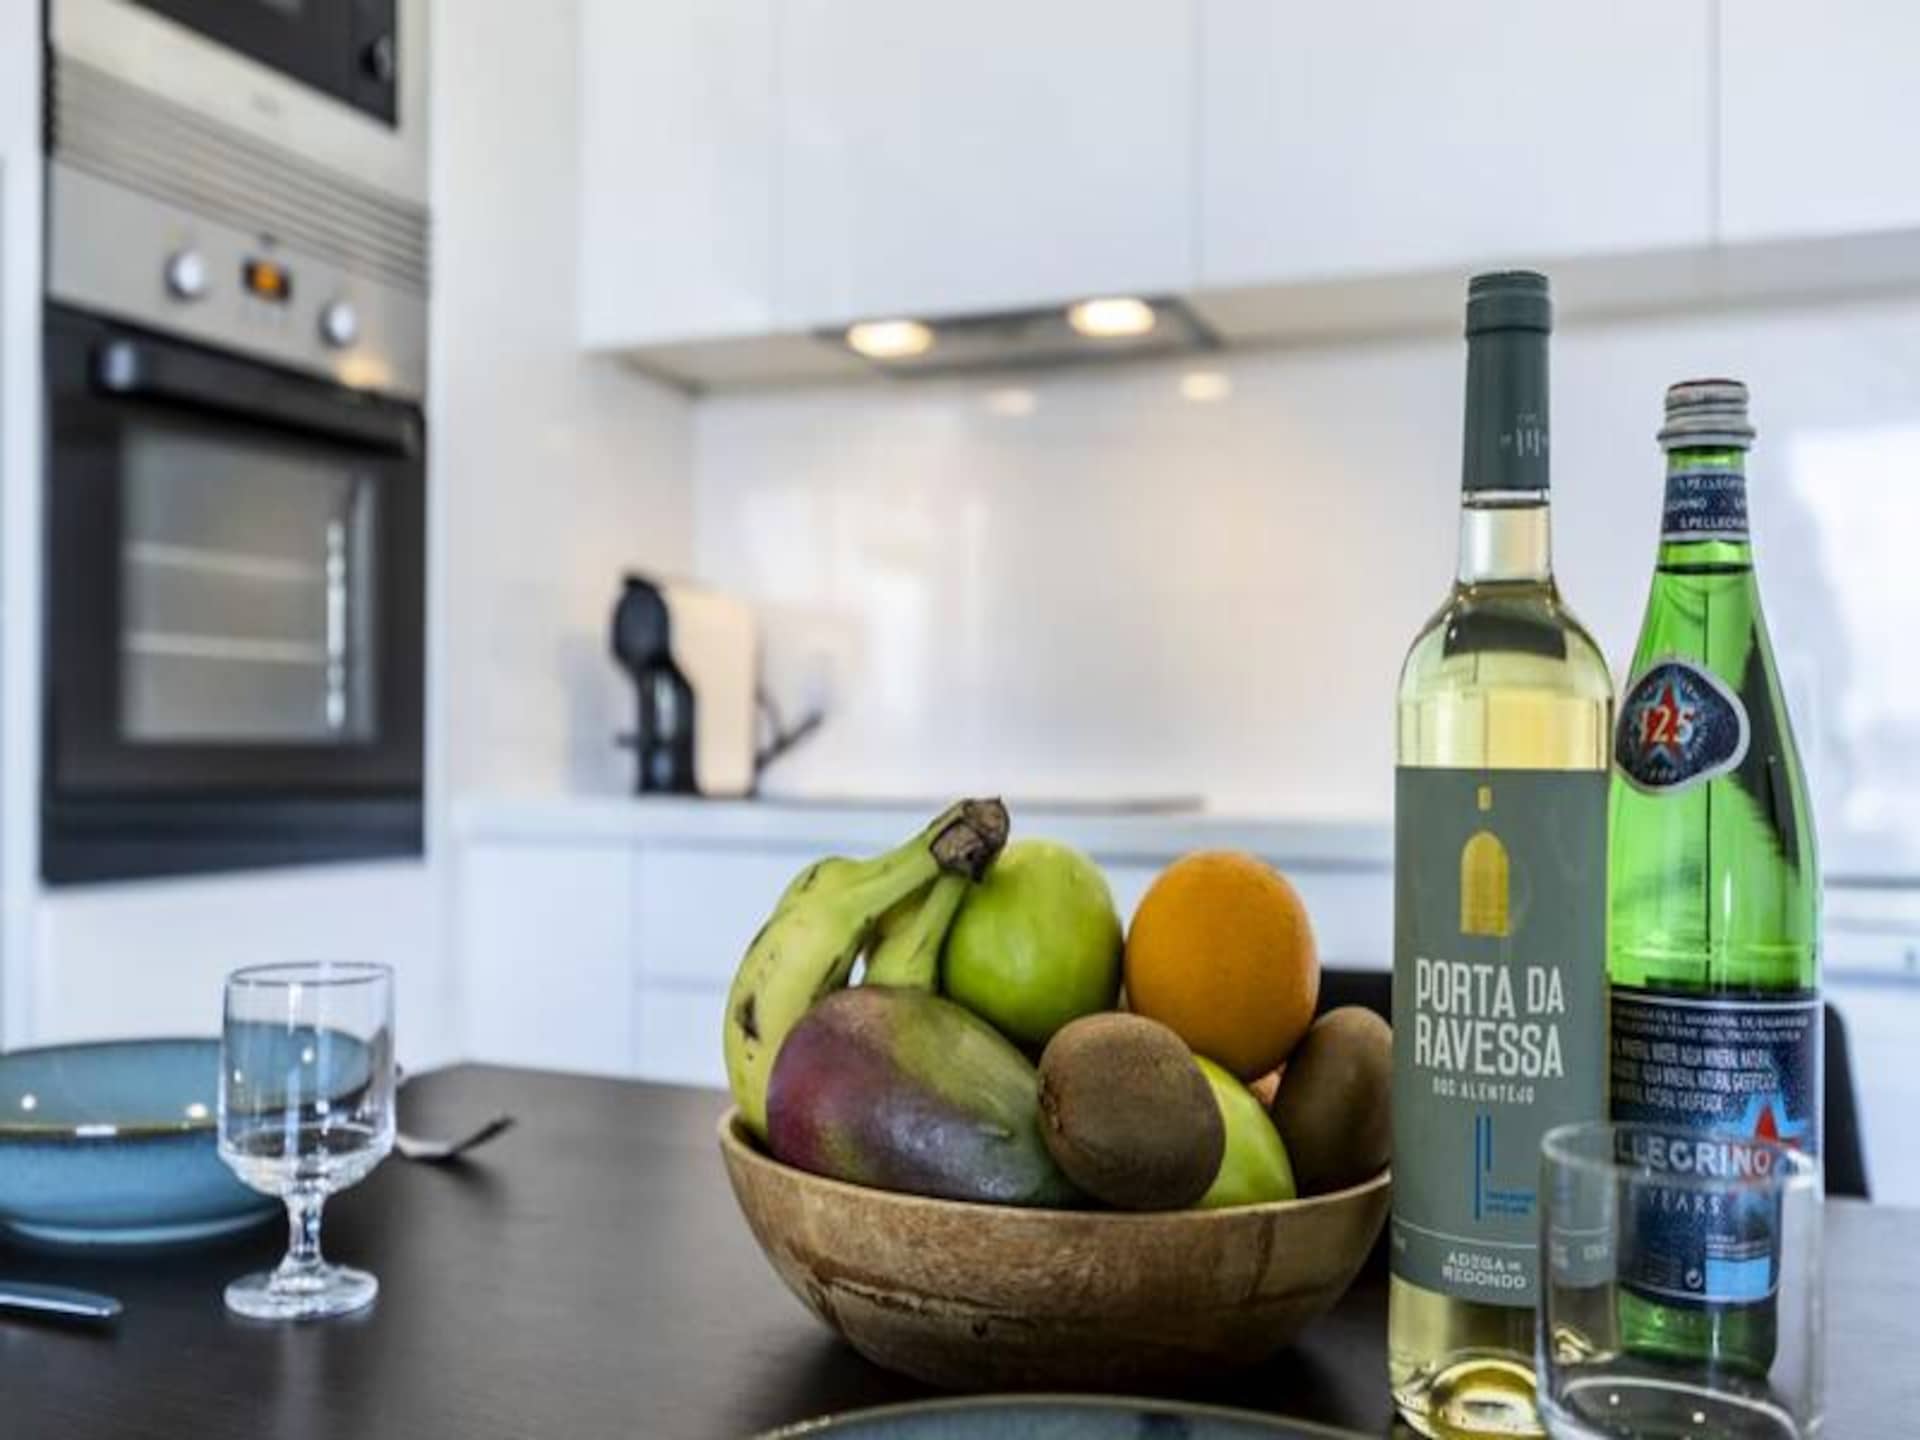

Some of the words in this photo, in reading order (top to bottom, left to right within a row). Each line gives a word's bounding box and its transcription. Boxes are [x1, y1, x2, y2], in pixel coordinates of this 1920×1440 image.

[1415, 958, 1516, 1019] PORTA
[1527, 965, 1566, 1015] DA
[1414, 1013, 1565, 1078] RAVESSA
[1441, 1265, 1527, 1288] REDONDO
[1448, 1251, 1504, 1272] ADEGA
